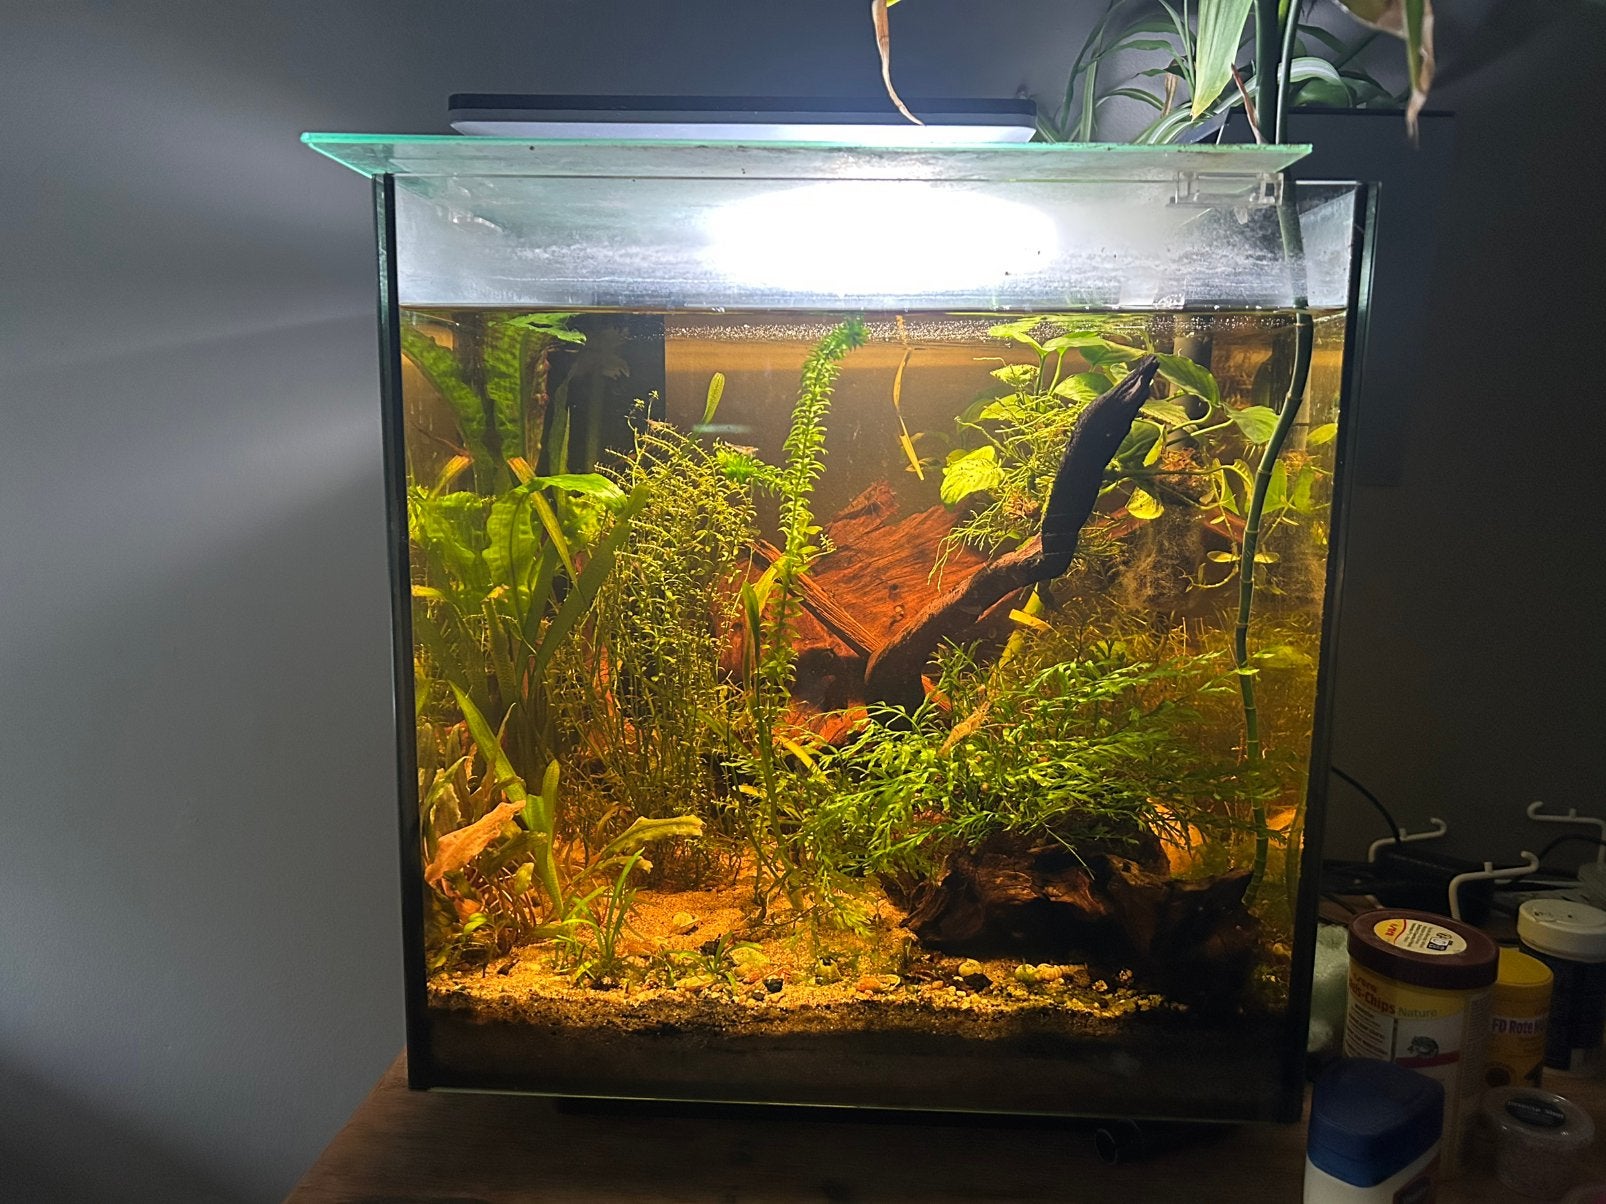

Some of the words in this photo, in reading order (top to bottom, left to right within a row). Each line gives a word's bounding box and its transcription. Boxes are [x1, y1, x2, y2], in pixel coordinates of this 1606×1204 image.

[1398, 1007, 1438, 1018] Nature
[1492, 1018, 1507, 1033] FD
[1509, 1020, 1534, 1034] Rote
